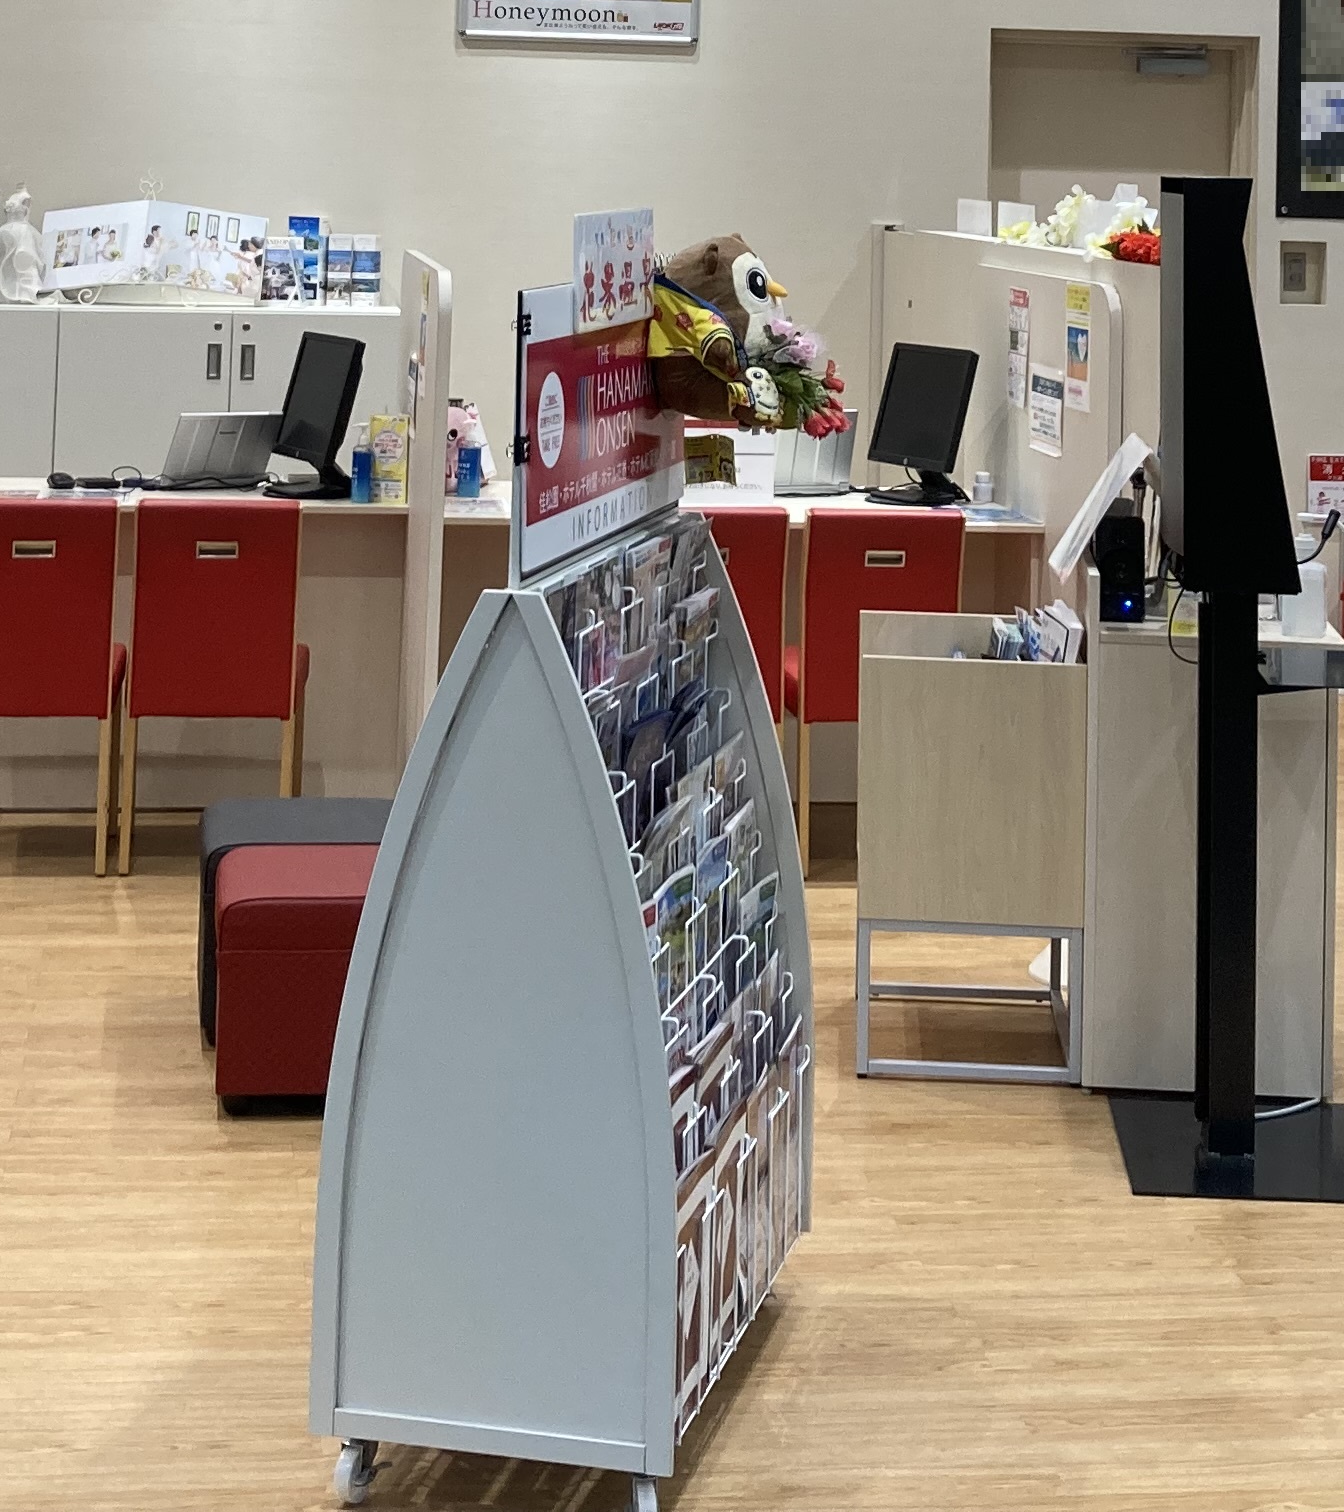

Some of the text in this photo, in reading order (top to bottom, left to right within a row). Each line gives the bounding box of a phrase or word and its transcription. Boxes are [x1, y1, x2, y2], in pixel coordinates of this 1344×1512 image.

[472, 0, 616, 27] Honeymoon
[597, 343, 610, 366] THE
[596, 357, 656, 412] HANAMAK
[596, 407, 636, 457] ONSEN
